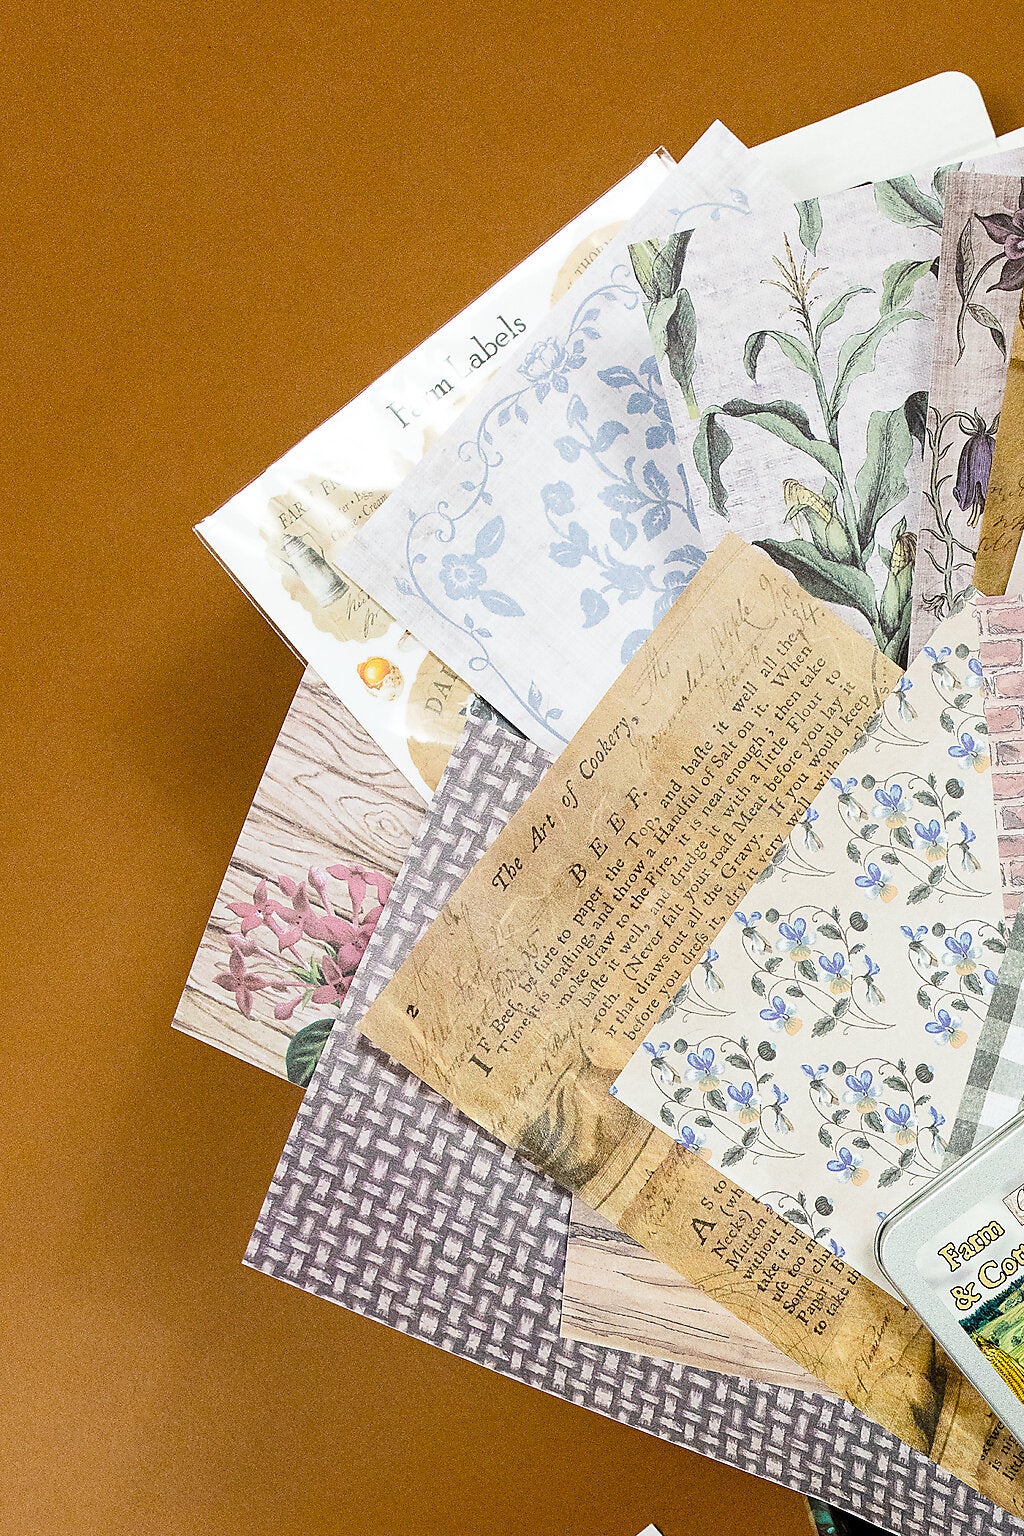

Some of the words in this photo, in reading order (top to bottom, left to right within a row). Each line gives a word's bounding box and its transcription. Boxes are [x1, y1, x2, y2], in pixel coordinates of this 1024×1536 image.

[652, 784, 703, 846] Handful
[709, 738, 739, 770] Salt
[769, 643, 813, 689] When
[719, 830, 766, 881] Gravy.
[806, 723, 845, 769] would
[838, 692, 872, 728] keep
[755, 735, 790, 772] little
[785, 690, 824, 735] Flour
[490, 855, 525, 893] The
[527, 812, 557, 854] Art
[558, 778, 582, 810] of
[577, 712, 640, 782] Cookery,
[571, 885, 605, 927] paper
[623, 814, 661, 850] Top,
[730, 680, 759, 714] well
[643, 852, 679, 888] Fire,
[723, 735, 768, 787] enough
[621, 928, 665, 982] (Never
[730, 793, 769, 835] Meat
[762, 747, 804, 794] before
[723, 1216, 769, 1272] Mutton
[740, 1227, 783, 1281] without
[781, 1275, 814, 1315] Some
[937, 1217, 1005, 1274] Farm
[953, 1277, 983, 1312] &
